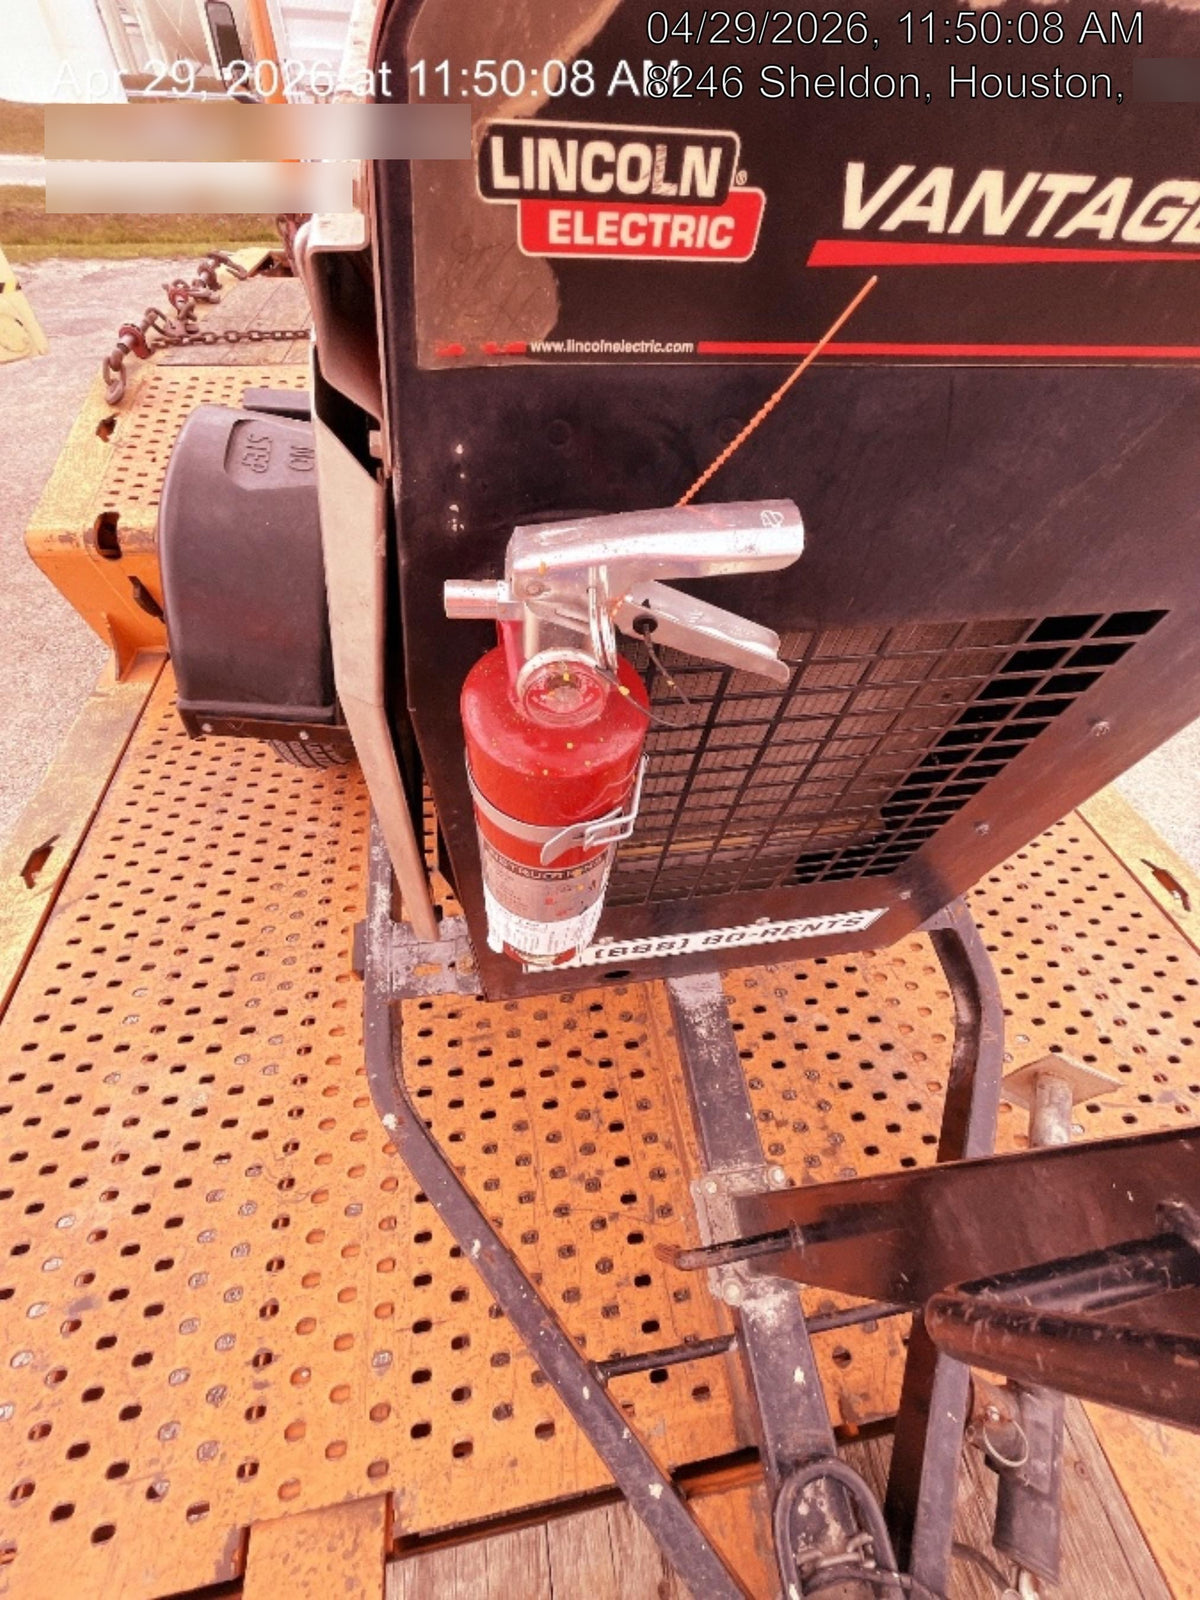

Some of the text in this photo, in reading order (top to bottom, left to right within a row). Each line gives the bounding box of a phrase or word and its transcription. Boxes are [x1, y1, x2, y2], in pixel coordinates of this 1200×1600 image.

[490, 136, 723, 198] LINCOLN
[548, 209, 736, 250] ELECTRIC
[529, 339, 694, 354] www.lincolnelectric.com
[241, 433, 273, 474] STEP
